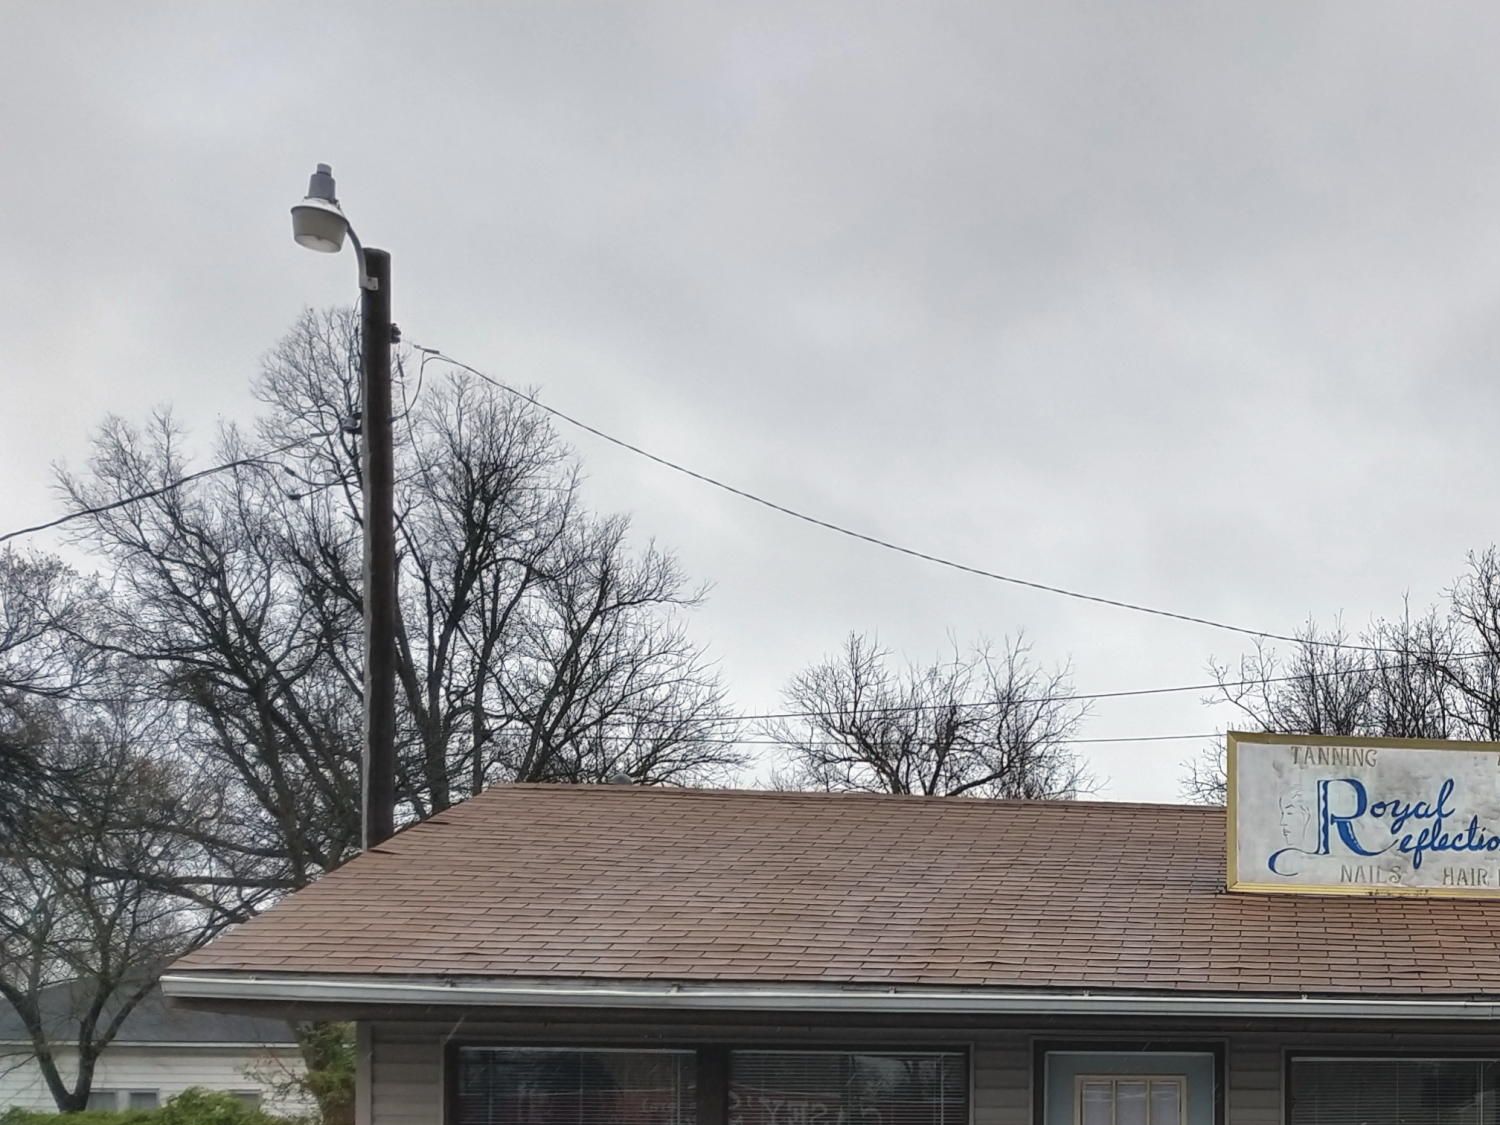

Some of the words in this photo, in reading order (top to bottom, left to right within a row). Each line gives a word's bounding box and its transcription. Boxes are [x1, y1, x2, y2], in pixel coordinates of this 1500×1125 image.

[1291, 746, 1378, 768] TANNING
[1267, 778, 1456, 876] Royal
[1340, 865, 1402, 884] NAILS
[1443, 867, 1488, 887] HAIR
